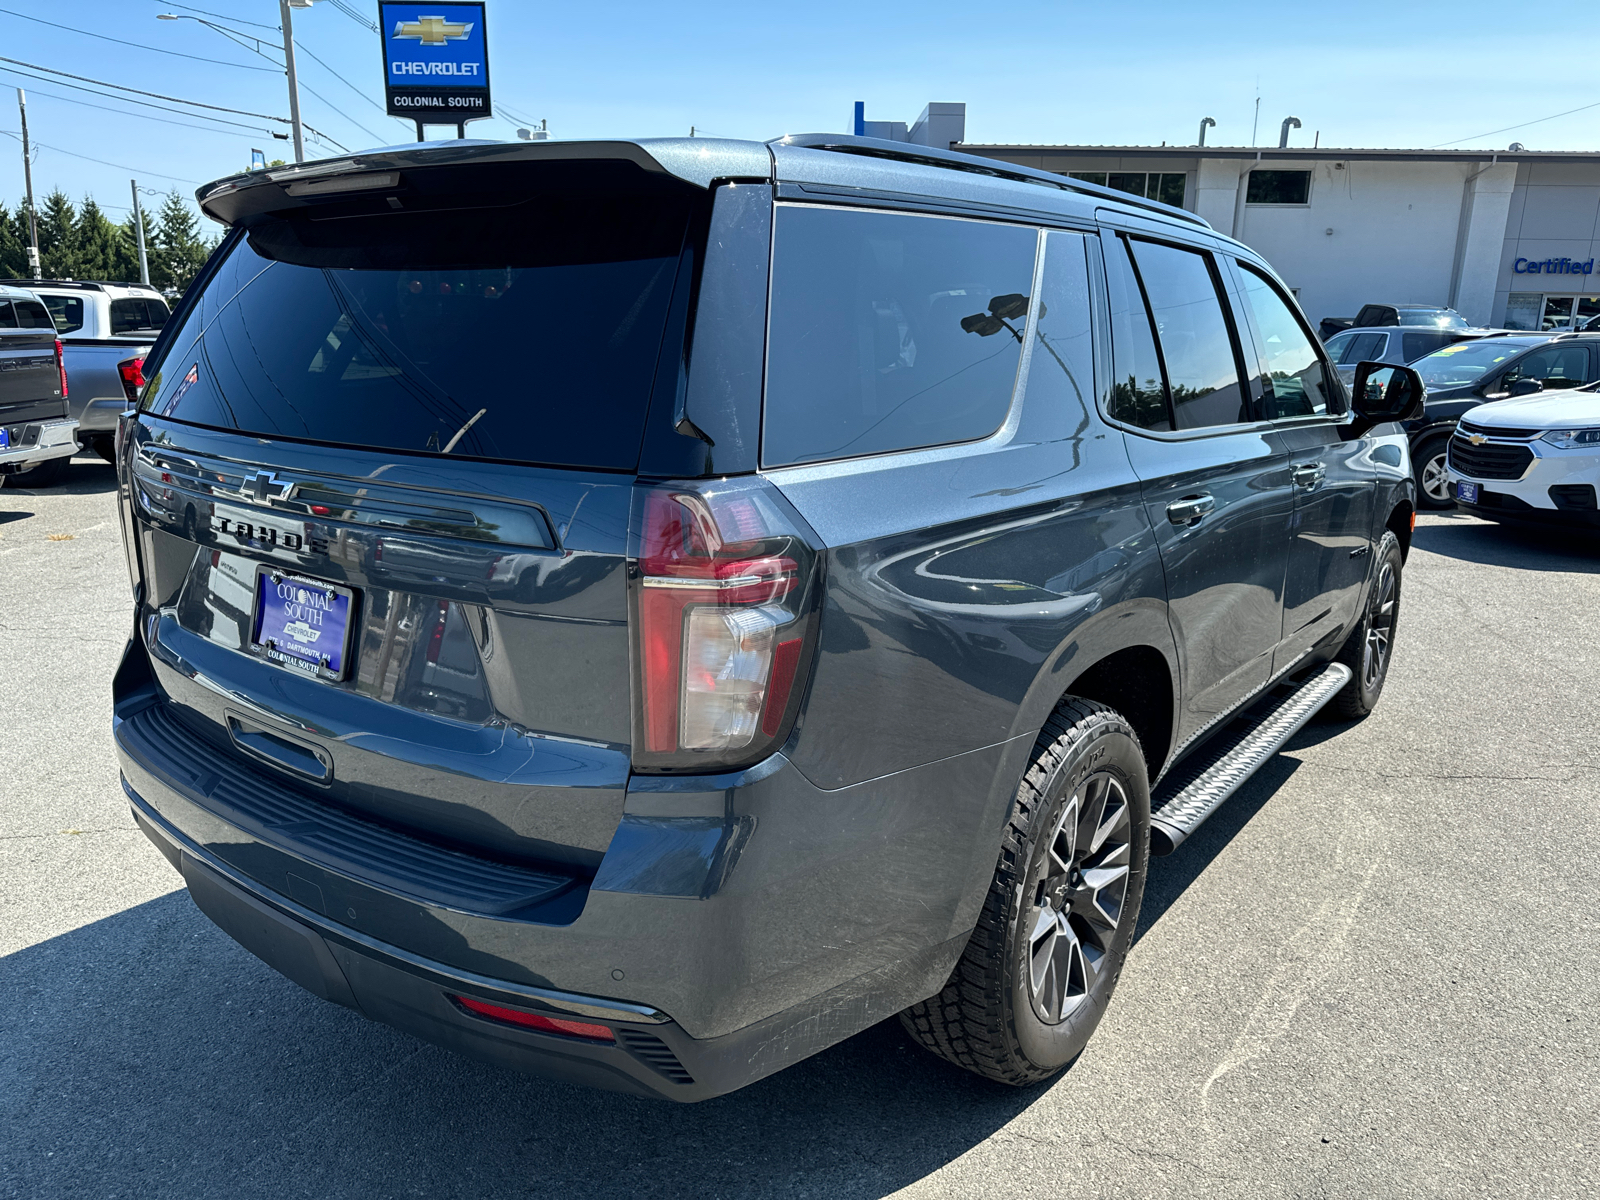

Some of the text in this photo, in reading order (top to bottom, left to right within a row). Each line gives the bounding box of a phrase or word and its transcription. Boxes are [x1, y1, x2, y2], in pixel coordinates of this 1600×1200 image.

[392, 61, 480, 76] CHEVROLET
[394, 96, 483, 107] COLONIAL SOUTH
[1514, 257, 1595, 275] Certified
[215, 516, 330, 556] TAHOE
[277, 583, 334, 612] COLONIAL
[284, 601, 323, 626] SOUTH
[286, 624, 317, 640] CHEVROLET
[287, 642, 321, 660] DARTMOUTH,
[267, 649, 320, 674] COLONIAL SOUTH
